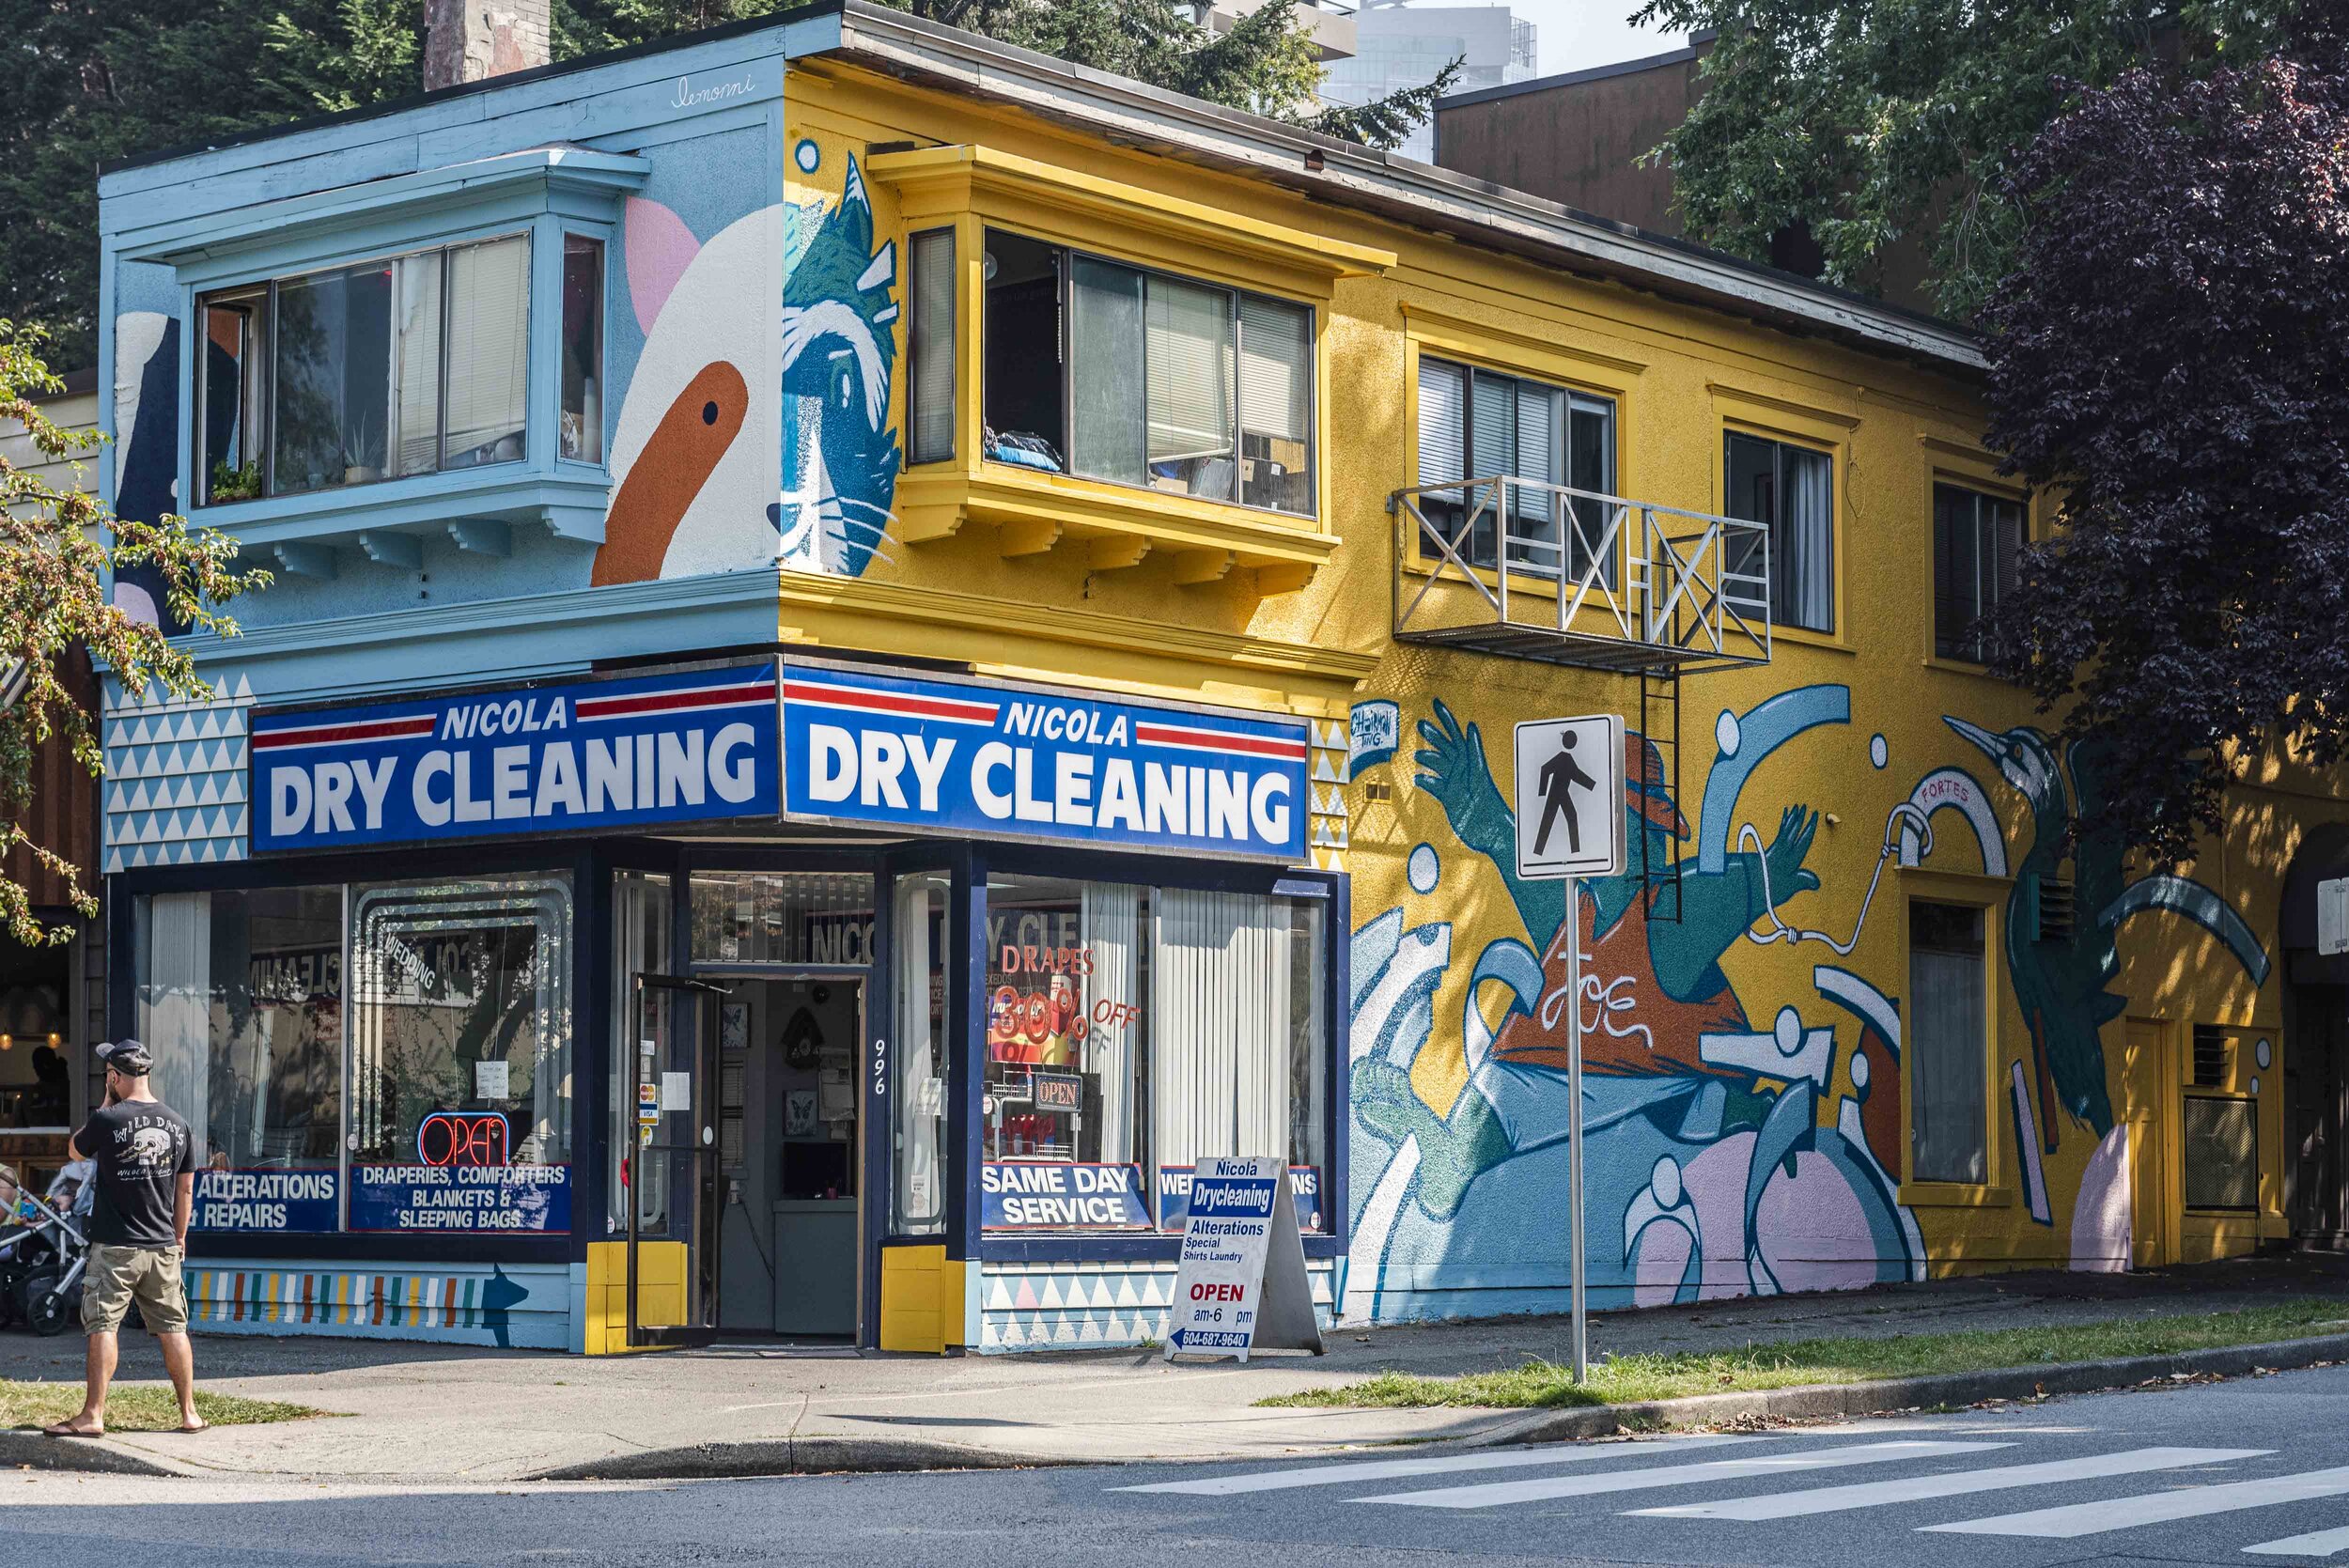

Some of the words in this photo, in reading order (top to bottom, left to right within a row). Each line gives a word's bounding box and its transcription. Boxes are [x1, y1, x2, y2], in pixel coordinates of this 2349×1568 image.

[442, 696, 567, 741] NICOLA
[1003, 702, 1128, 747] NICOLA
[271, 756, 398, 836] DRY
[412, 722, 755, 827] CLEANING
[809, 723, 957, 812] DRY
[971, 741, 1291, 845] CLEANING
[1921, 780, 1969, 803] FORTES
[384, 931, 436, 989] WEDDING
[1003, 945, 1095, 976] DRAPES
[994, 986, 1089, 1045] 30%
[1094, 999, 1141, 1029] OFF
[875, 1039, 885, 1094] 996
[1039, 1081, 1077, 1105] OPEN
[113, 1116, 150, 1143] WILD
[156, 1116, 184, 1146] DAYS
[421, 1116, 507, 1165] OPEN
[363, 1166, 453, 1186] DRAPERIES,
[458, 1165, 566, 1185] COMFORTERS
[982, 1166, 1066, 1193] SAME
[1073, 1167, 1130, 1193] DAY
[1216, 1161, 1257, 1176] Nicola
[196, 1174, 334, 1200] ALTERATIONS
[412, 1189, 495, 1208] BLANKETS
[499, 1189, 511, 1208] &
[1194, 1182, 1270, 1213] Drycleaning
[204, 1203, 287, 1228] REPAIRS
[399, 1210, 473, 1229] SLEEPING
[477, 1210, 521, 1229] BAGS
[1003, 1197, 1128, 1224] SERVICE
[1190, 1219, 1264, 1235] Alterations
[1186, 1236, 1221, 1249] Special
[1183, 1250, 1208, 1262] Shirts
[1209, 1250, 1243, 1264] Laundry
[1190, 1283, 1245, 1302] OPEN
[1236, 1311, 1252, 1326] pm
[1182, 1331, 1245, 1347] 604-687-9640
